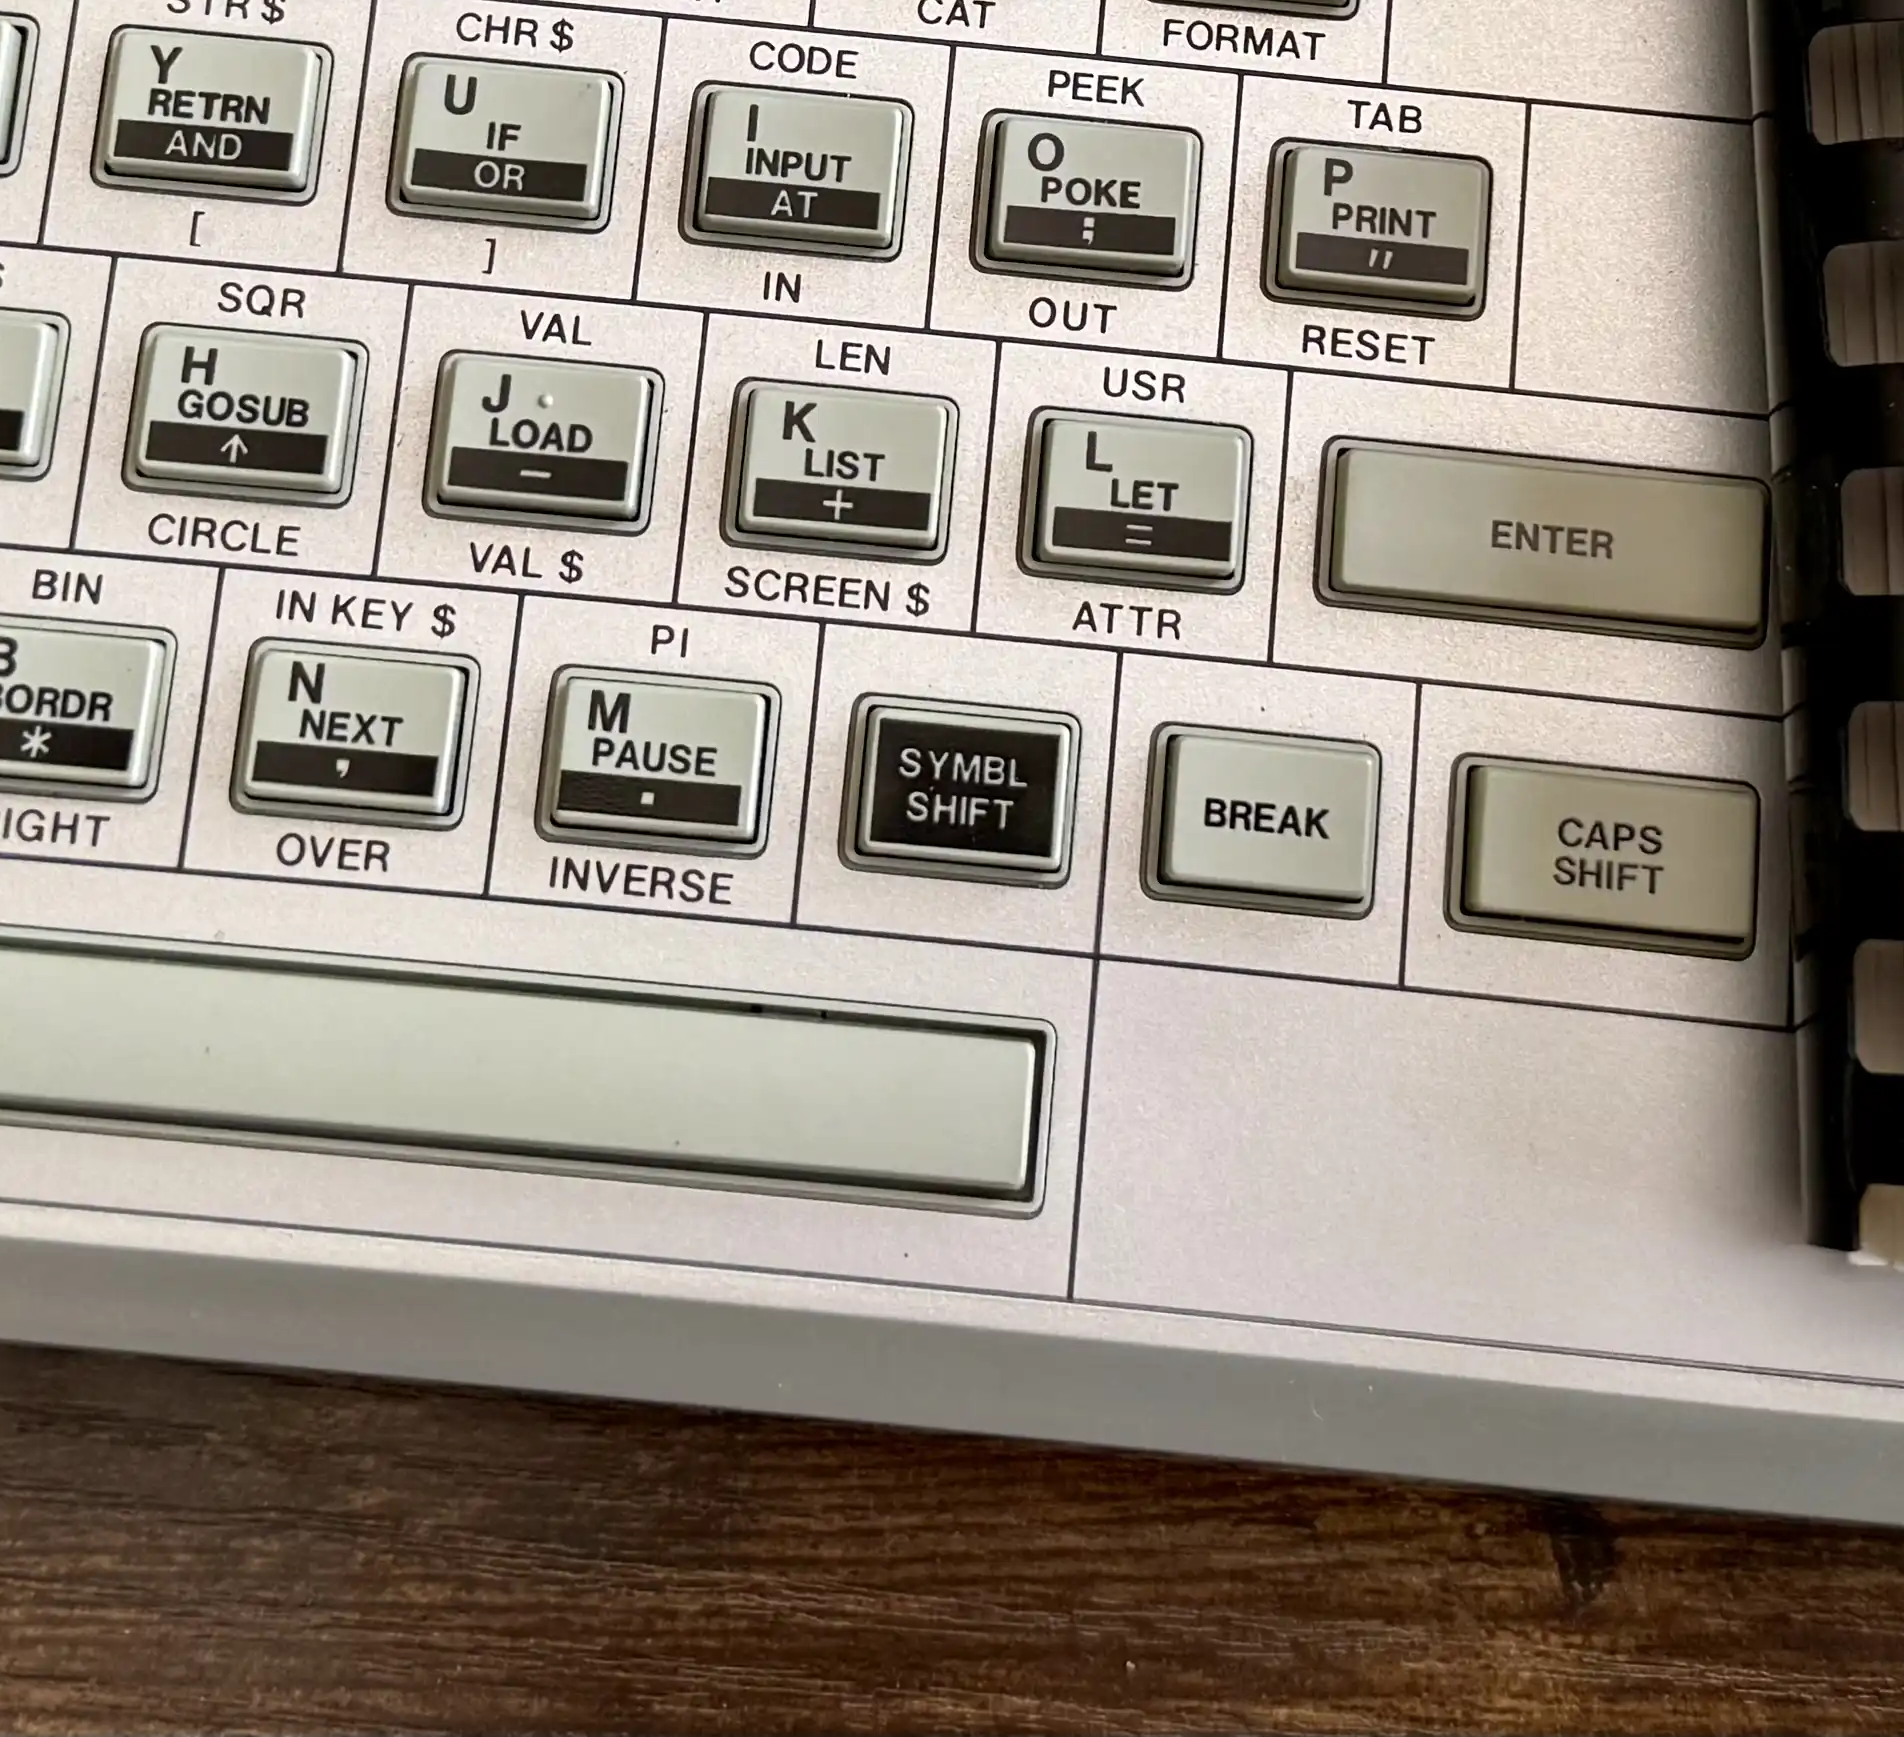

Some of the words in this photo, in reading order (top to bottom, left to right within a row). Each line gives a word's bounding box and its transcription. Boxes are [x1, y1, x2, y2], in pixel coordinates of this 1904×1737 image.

[1163, 19, 1326, 60] FORMAT
[750, 41, 859, 79] CODE
[148, 89, 271, 125] RETRN
[1048, 70, 1144, 107] PEEK
[1348, 100, 1422, 133] TAB
[166, 130, 241, 159] AND
[746, 148, 851, 182] INPUT
[1042, 177, 1140, 210] POKE
[1333, 203, 1436, 238] PRINT
[218, 282, 305, 318] SQR
[1029, 297, 1117, 334] OUT
[1302, 324, 1435, 364] RESET
[178, 392, 309, 427] GOSUB
[490, 418, 592, 452] LOAD
[805, 448, 885, 481] LIST
[148, 513, 301, 556] CIRCLE
[1492, 520, 1613, 559] ENTER
[33, 570, 102, 604] BIN
[1072, 601, 1181, 640] ATTR
[300, 709, 403, 746] NEXT
[592, 738, 717, 776] PAUSE
[900, 748, 1027, 787] SYMBL
[907, 792, 1013, 828] SHIFT
[1205, 798, 1328, 839] BREAK
[277, 833, 389, 872] OVER
[1558, 818, 1662, 854] CAPS
[550, 856, 733, 904] INVERSE
[1554, 856, 1663, 894] SHIFT
